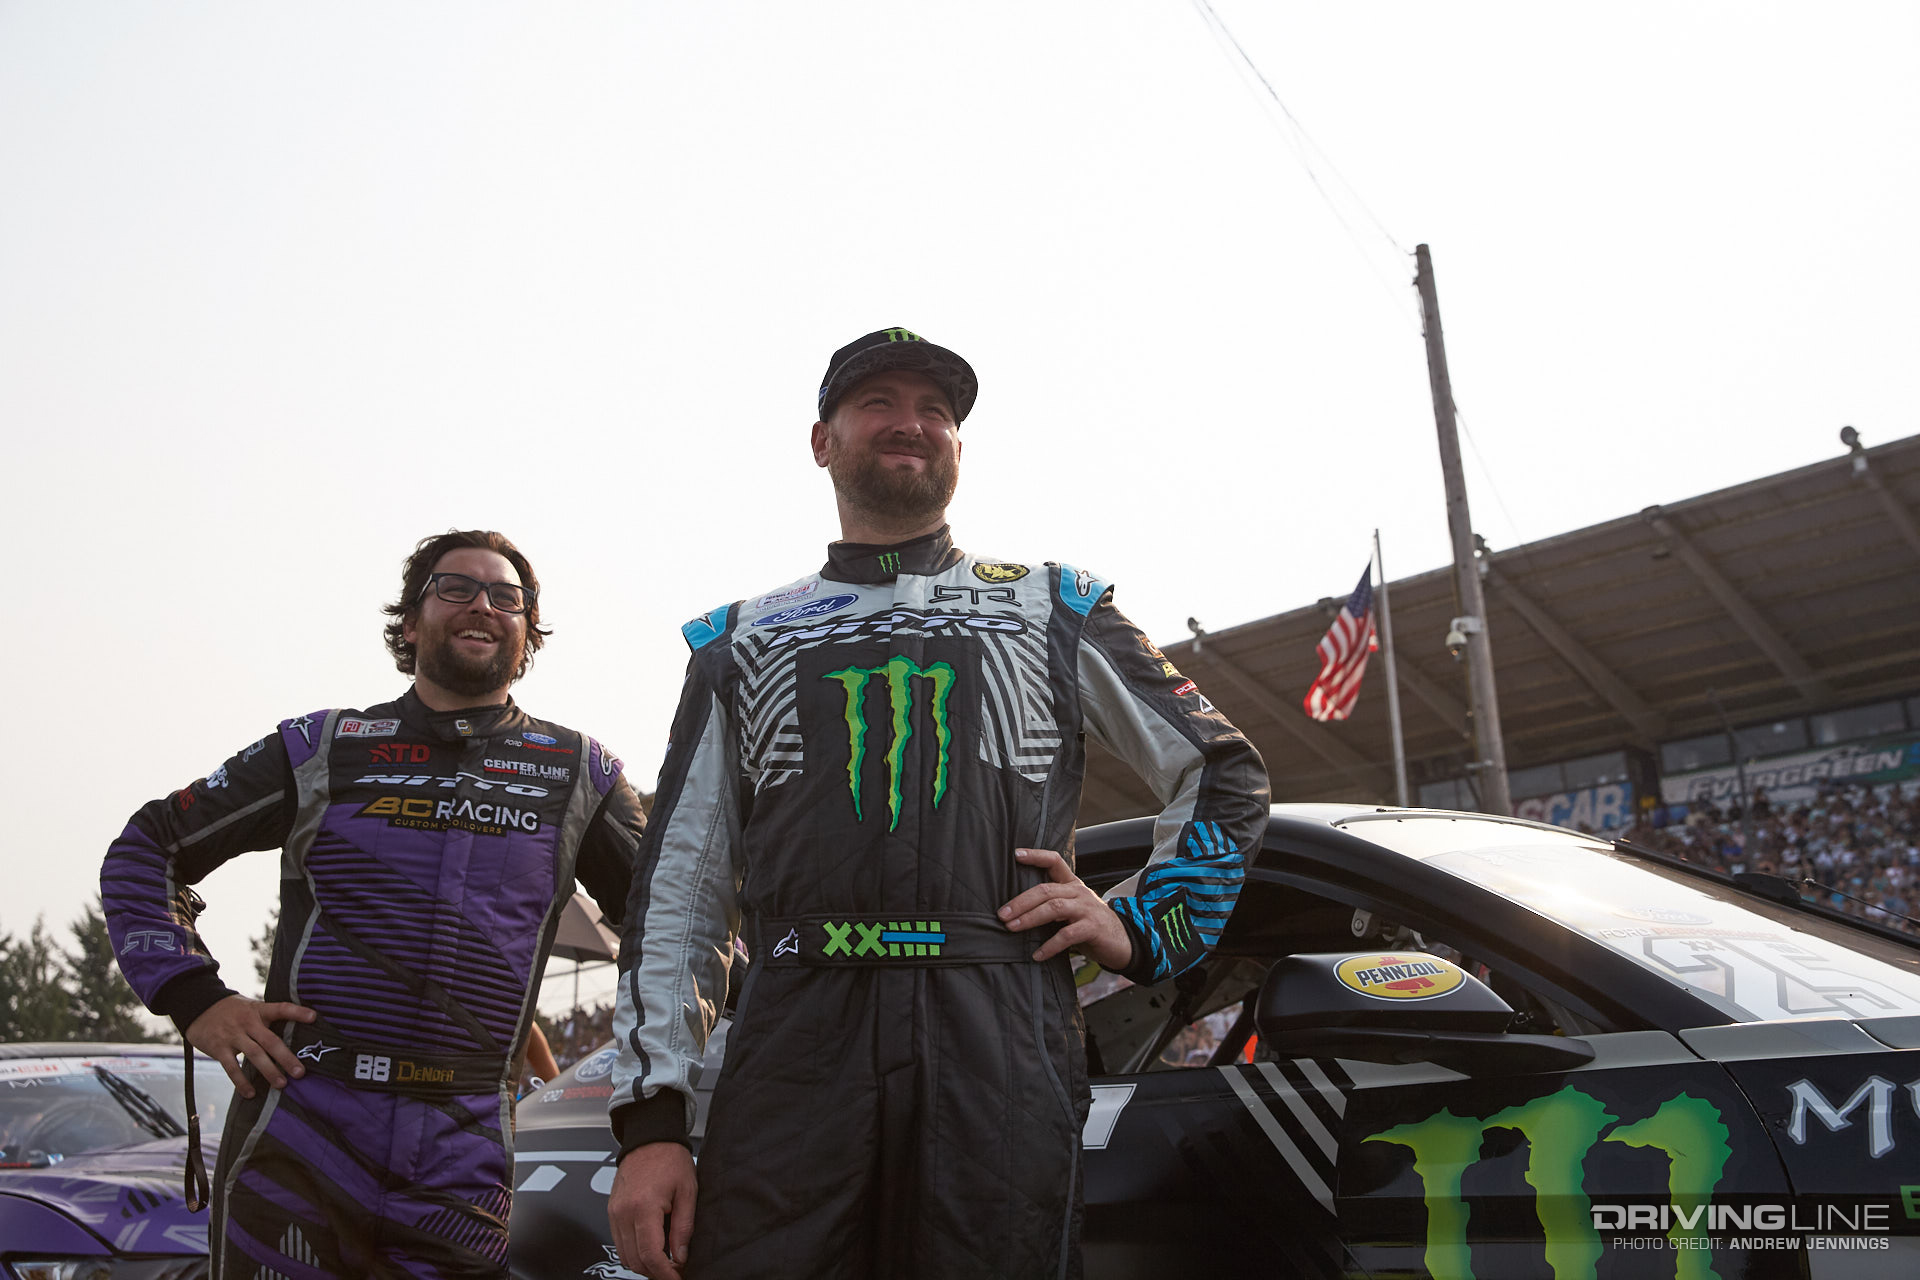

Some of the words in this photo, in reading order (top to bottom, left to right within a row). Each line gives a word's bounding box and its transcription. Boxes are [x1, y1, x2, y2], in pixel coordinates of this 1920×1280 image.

[773, 600, 837, 622] Ford
[768, 610, 1025, 648] NITTO
[345, 721, 359, 732] FD
[368, 743, 431, 763] ATD
[504, 739, 522, 748] FORD
[484, 758, 536, 772] CENTER
[540, 766, 570, 777] LINE
[354, 772, 550, 798] NITTO
[361, 796, 434, 817] BC
[436, 798, 538, 831] RACING
[394, 817, 439, 830] CUSTOM
[442, 819, 502, 834] COILOVERS
[1599, 927, 1651, 940] FORD
[1354, 961, 1444, 988] PENNZOIL
[354, 1053, 391, 1082] 88
[1785, 1075, 1920, 1160] M
